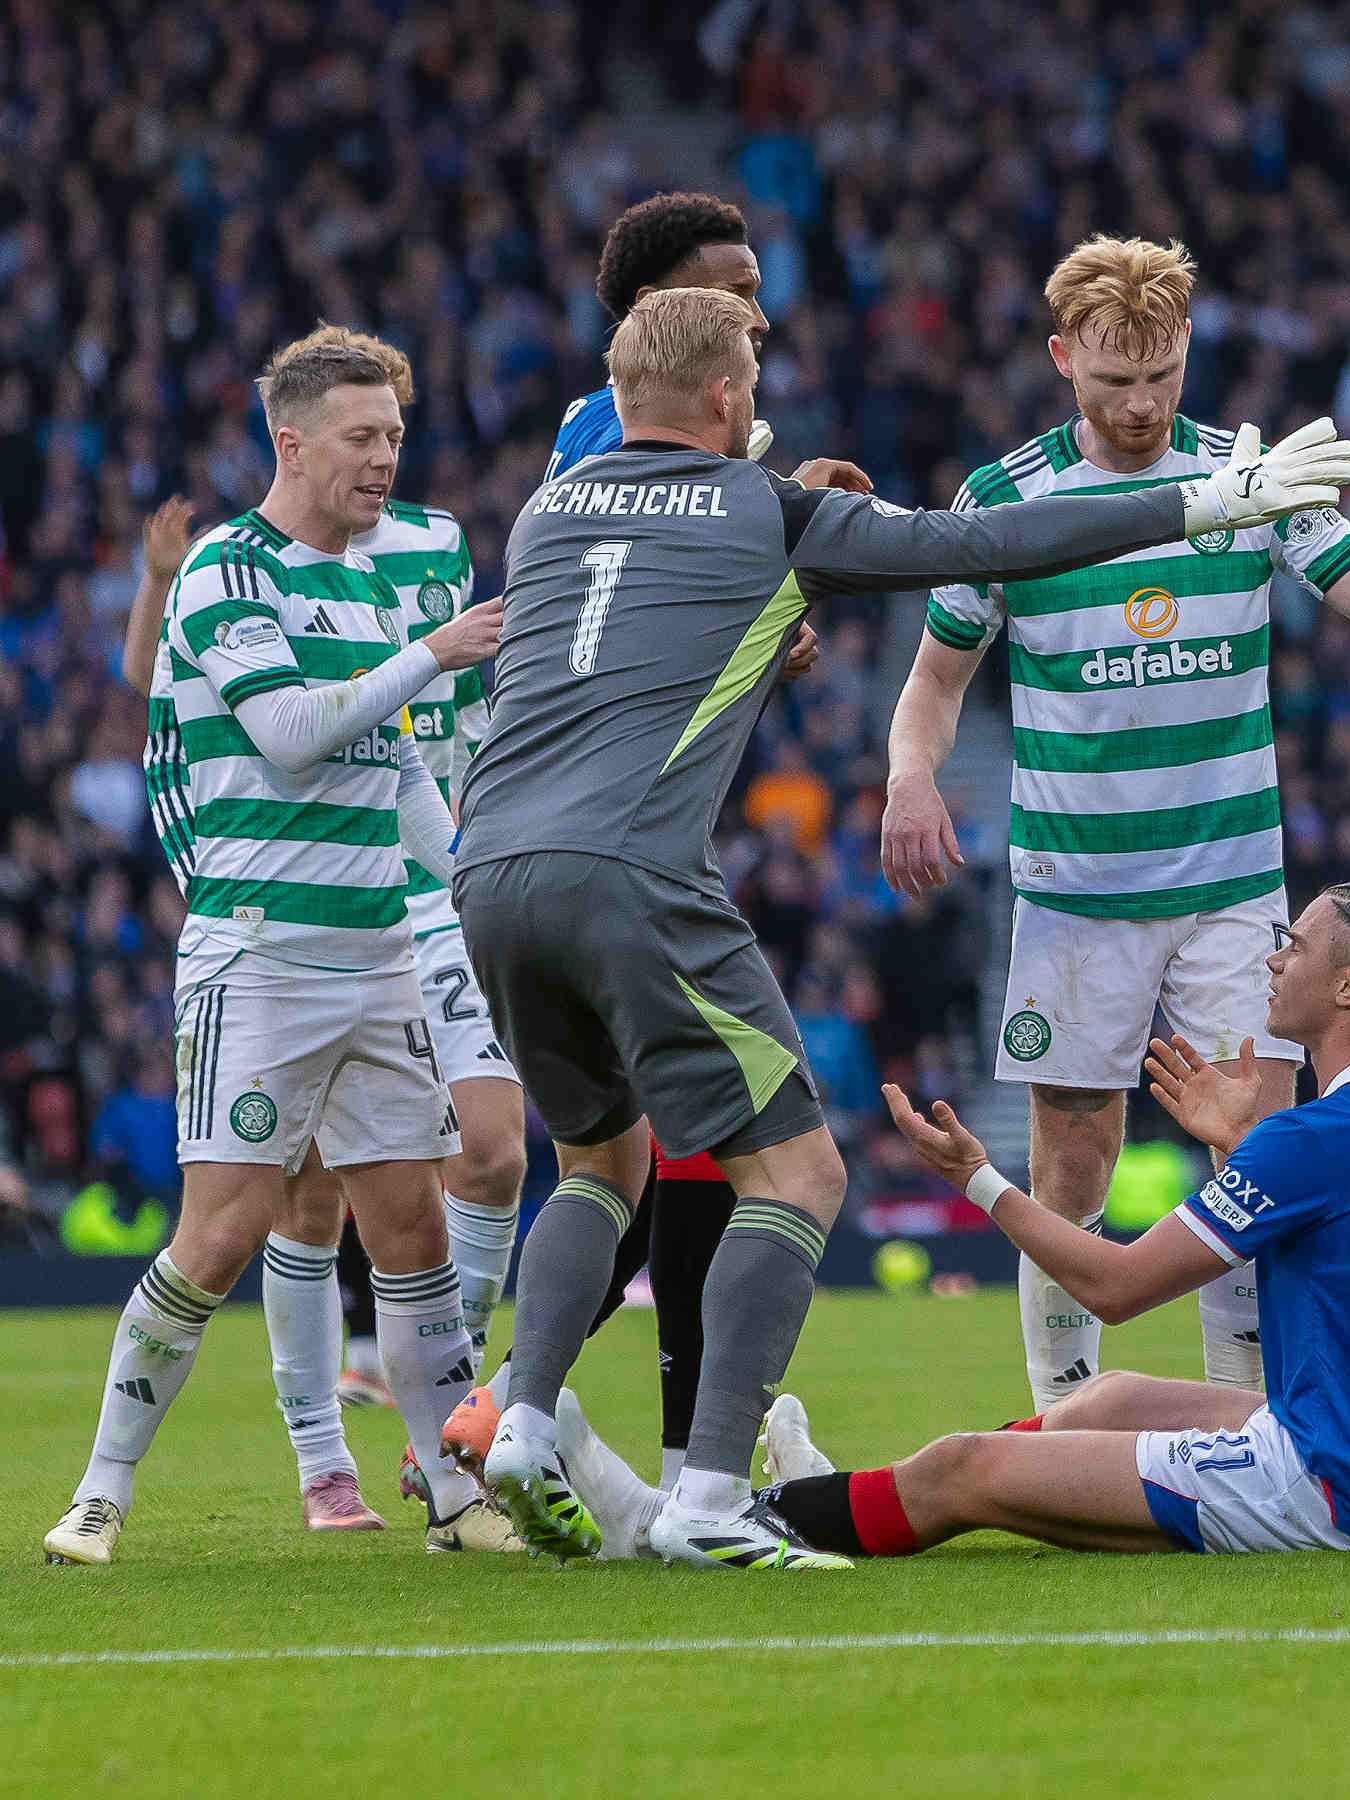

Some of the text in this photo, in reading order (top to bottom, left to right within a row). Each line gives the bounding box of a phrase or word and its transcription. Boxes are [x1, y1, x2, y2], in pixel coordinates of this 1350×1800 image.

[532, 482, 729, 517] SCHMEICHEL
[568, 540, 632, 677] 1
[1080, 639, 1234, 688] dafabet
